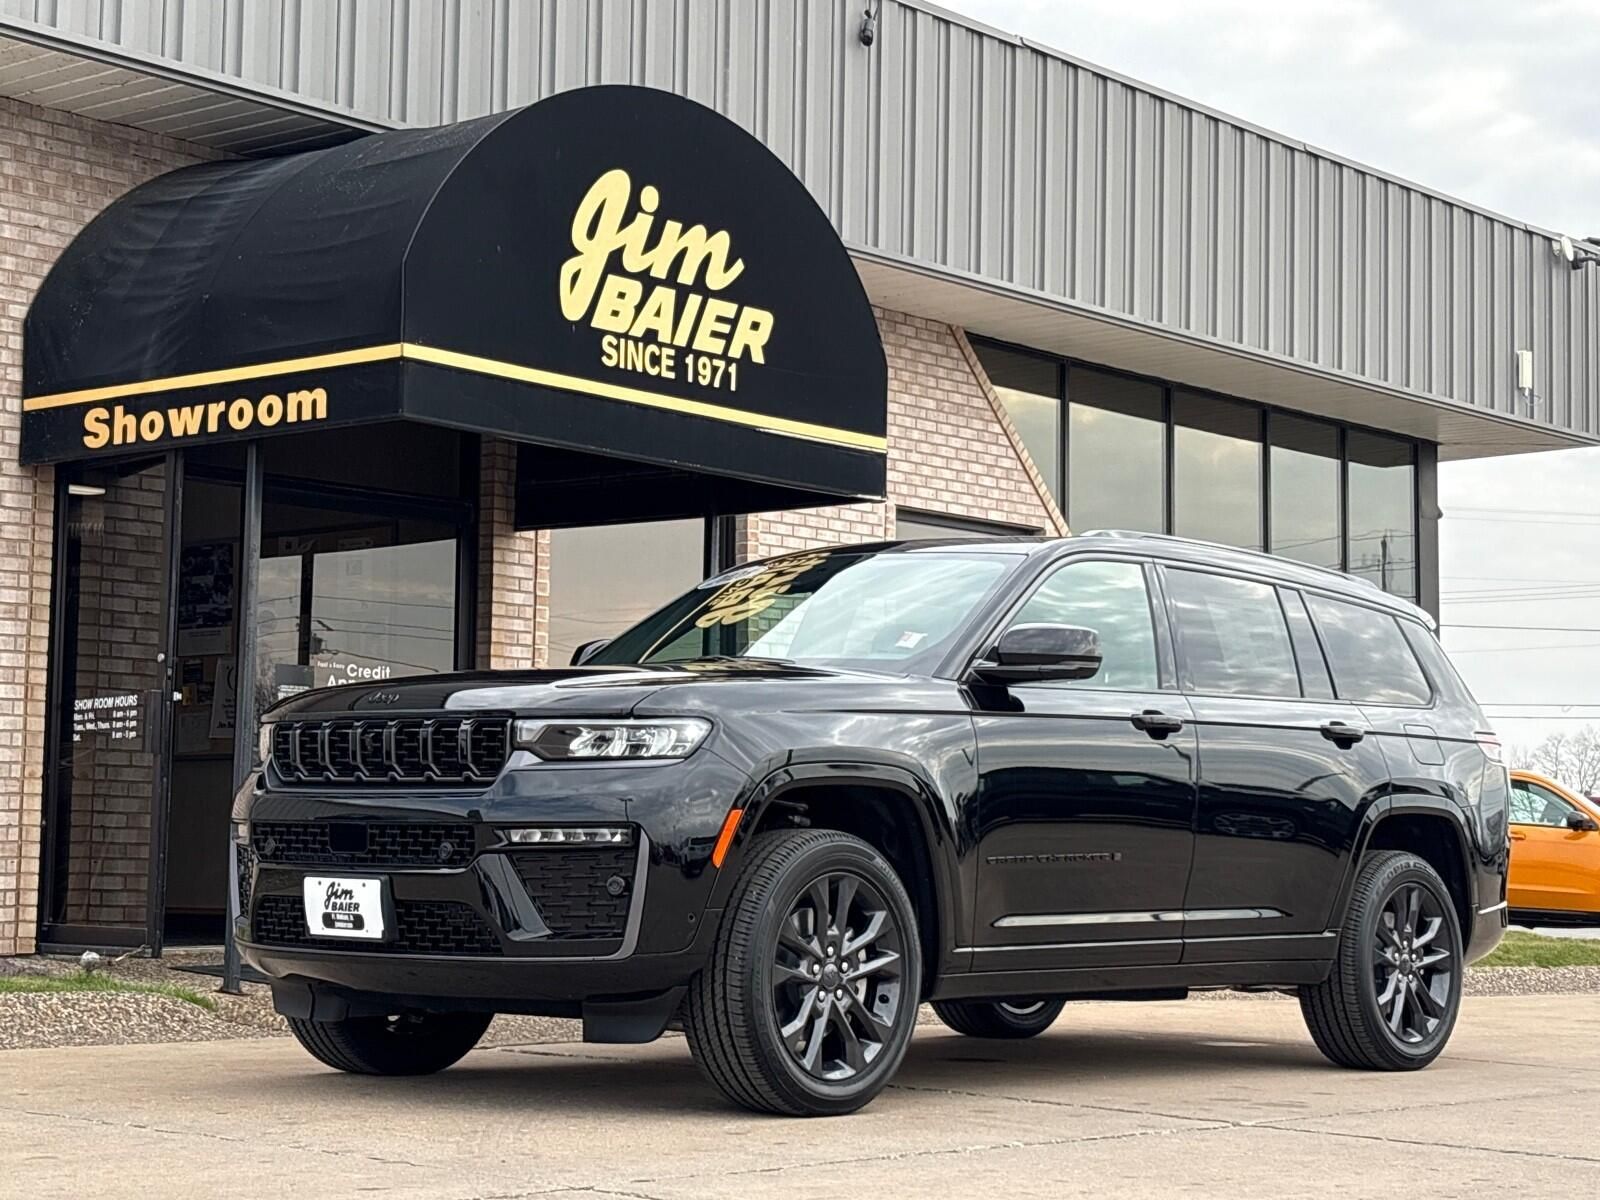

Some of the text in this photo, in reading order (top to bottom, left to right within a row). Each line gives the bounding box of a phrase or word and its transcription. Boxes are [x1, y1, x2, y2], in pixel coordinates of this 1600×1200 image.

[559, 168, 745, 322] Jim
[590, 273, 775, 365] BAIER
[600, 334, 738, 392] SINCE 1971
[83, 387, 327, 449] Showroom
[347, 663, 391, 679] Credit
[74, 695, 138, 710] SHOW ROOM HOURS
[324, 881, 354, 910] Jim
[331, 901, 360, 912] BAIER
